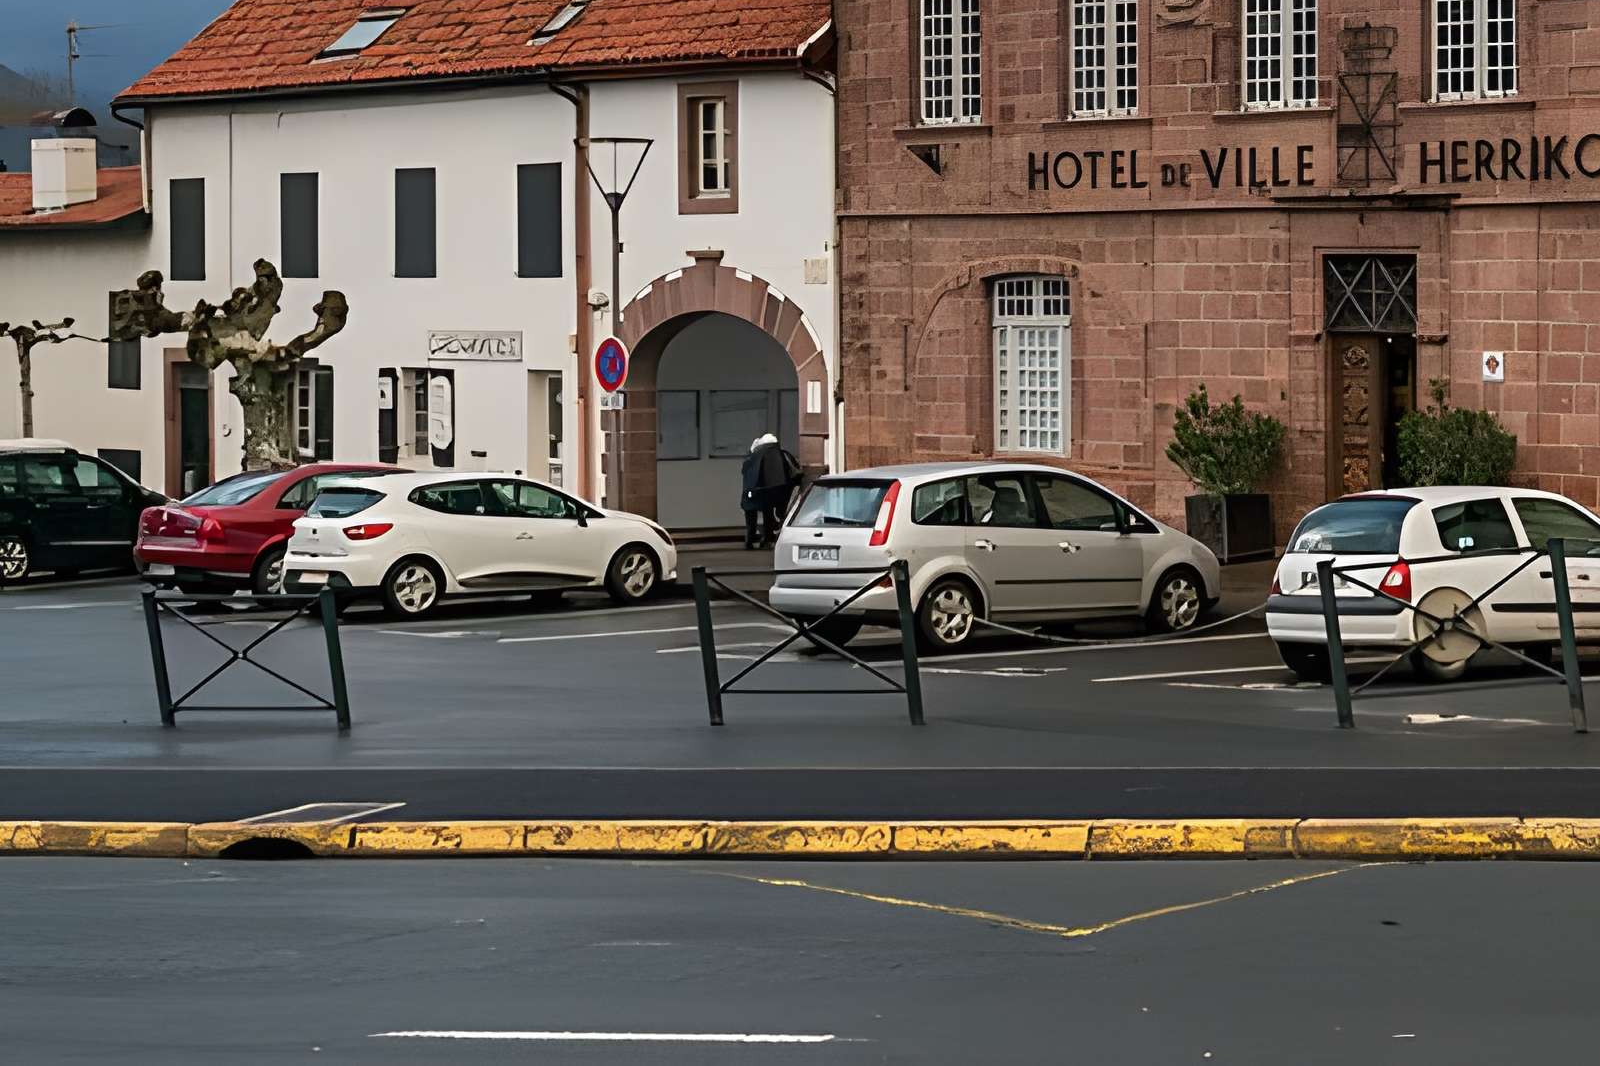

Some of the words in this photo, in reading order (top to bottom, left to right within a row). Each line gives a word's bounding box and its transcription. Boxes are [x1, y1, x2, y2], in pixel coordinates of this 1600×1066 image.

[1028, 149, 1149, 191] HOTEL
[1161, 163, 1192, 188] DE
[1200, 145, 1315, 188] VILLE
